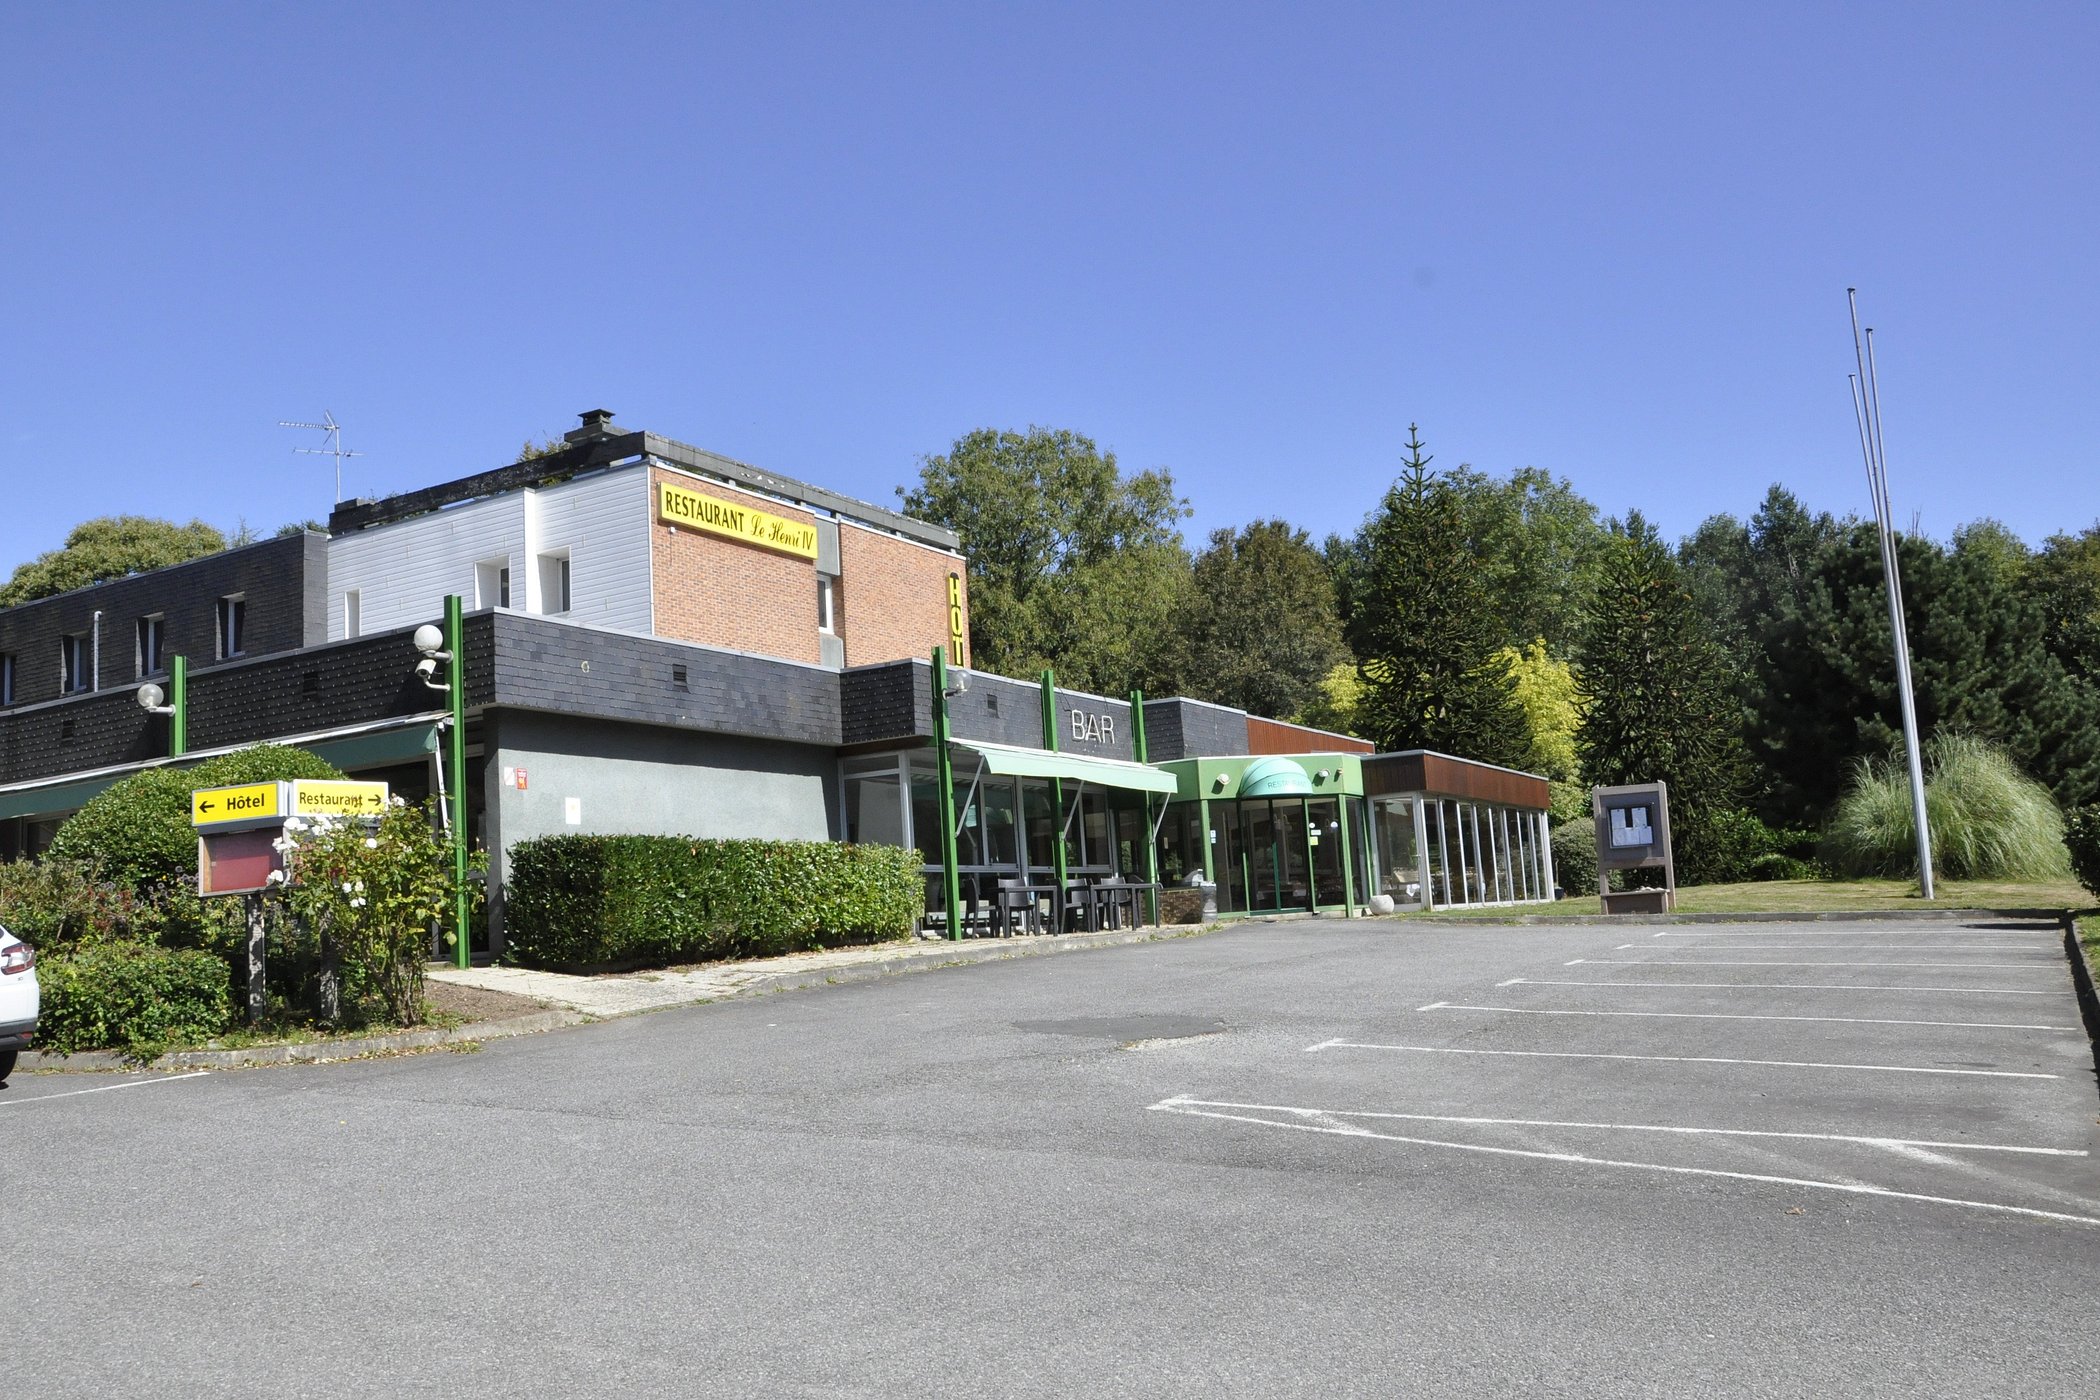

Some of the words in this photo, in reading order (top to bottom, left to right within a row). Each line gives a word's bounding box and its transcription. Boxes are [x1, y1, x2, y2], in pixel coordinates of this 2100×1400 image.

[666, 491, 744, 532] RESTAURANT
[751, 514, 765, 538] Le
[768, 522, 800, 548] Henri
[802, 531, 814, 550] IV
[950, 578, 964, 668] HOT
[1072, 709, 1115, 744] BAR
[227, 793, 265, 811] Hôtel
[299, 792, 363, 807] Restaurant
